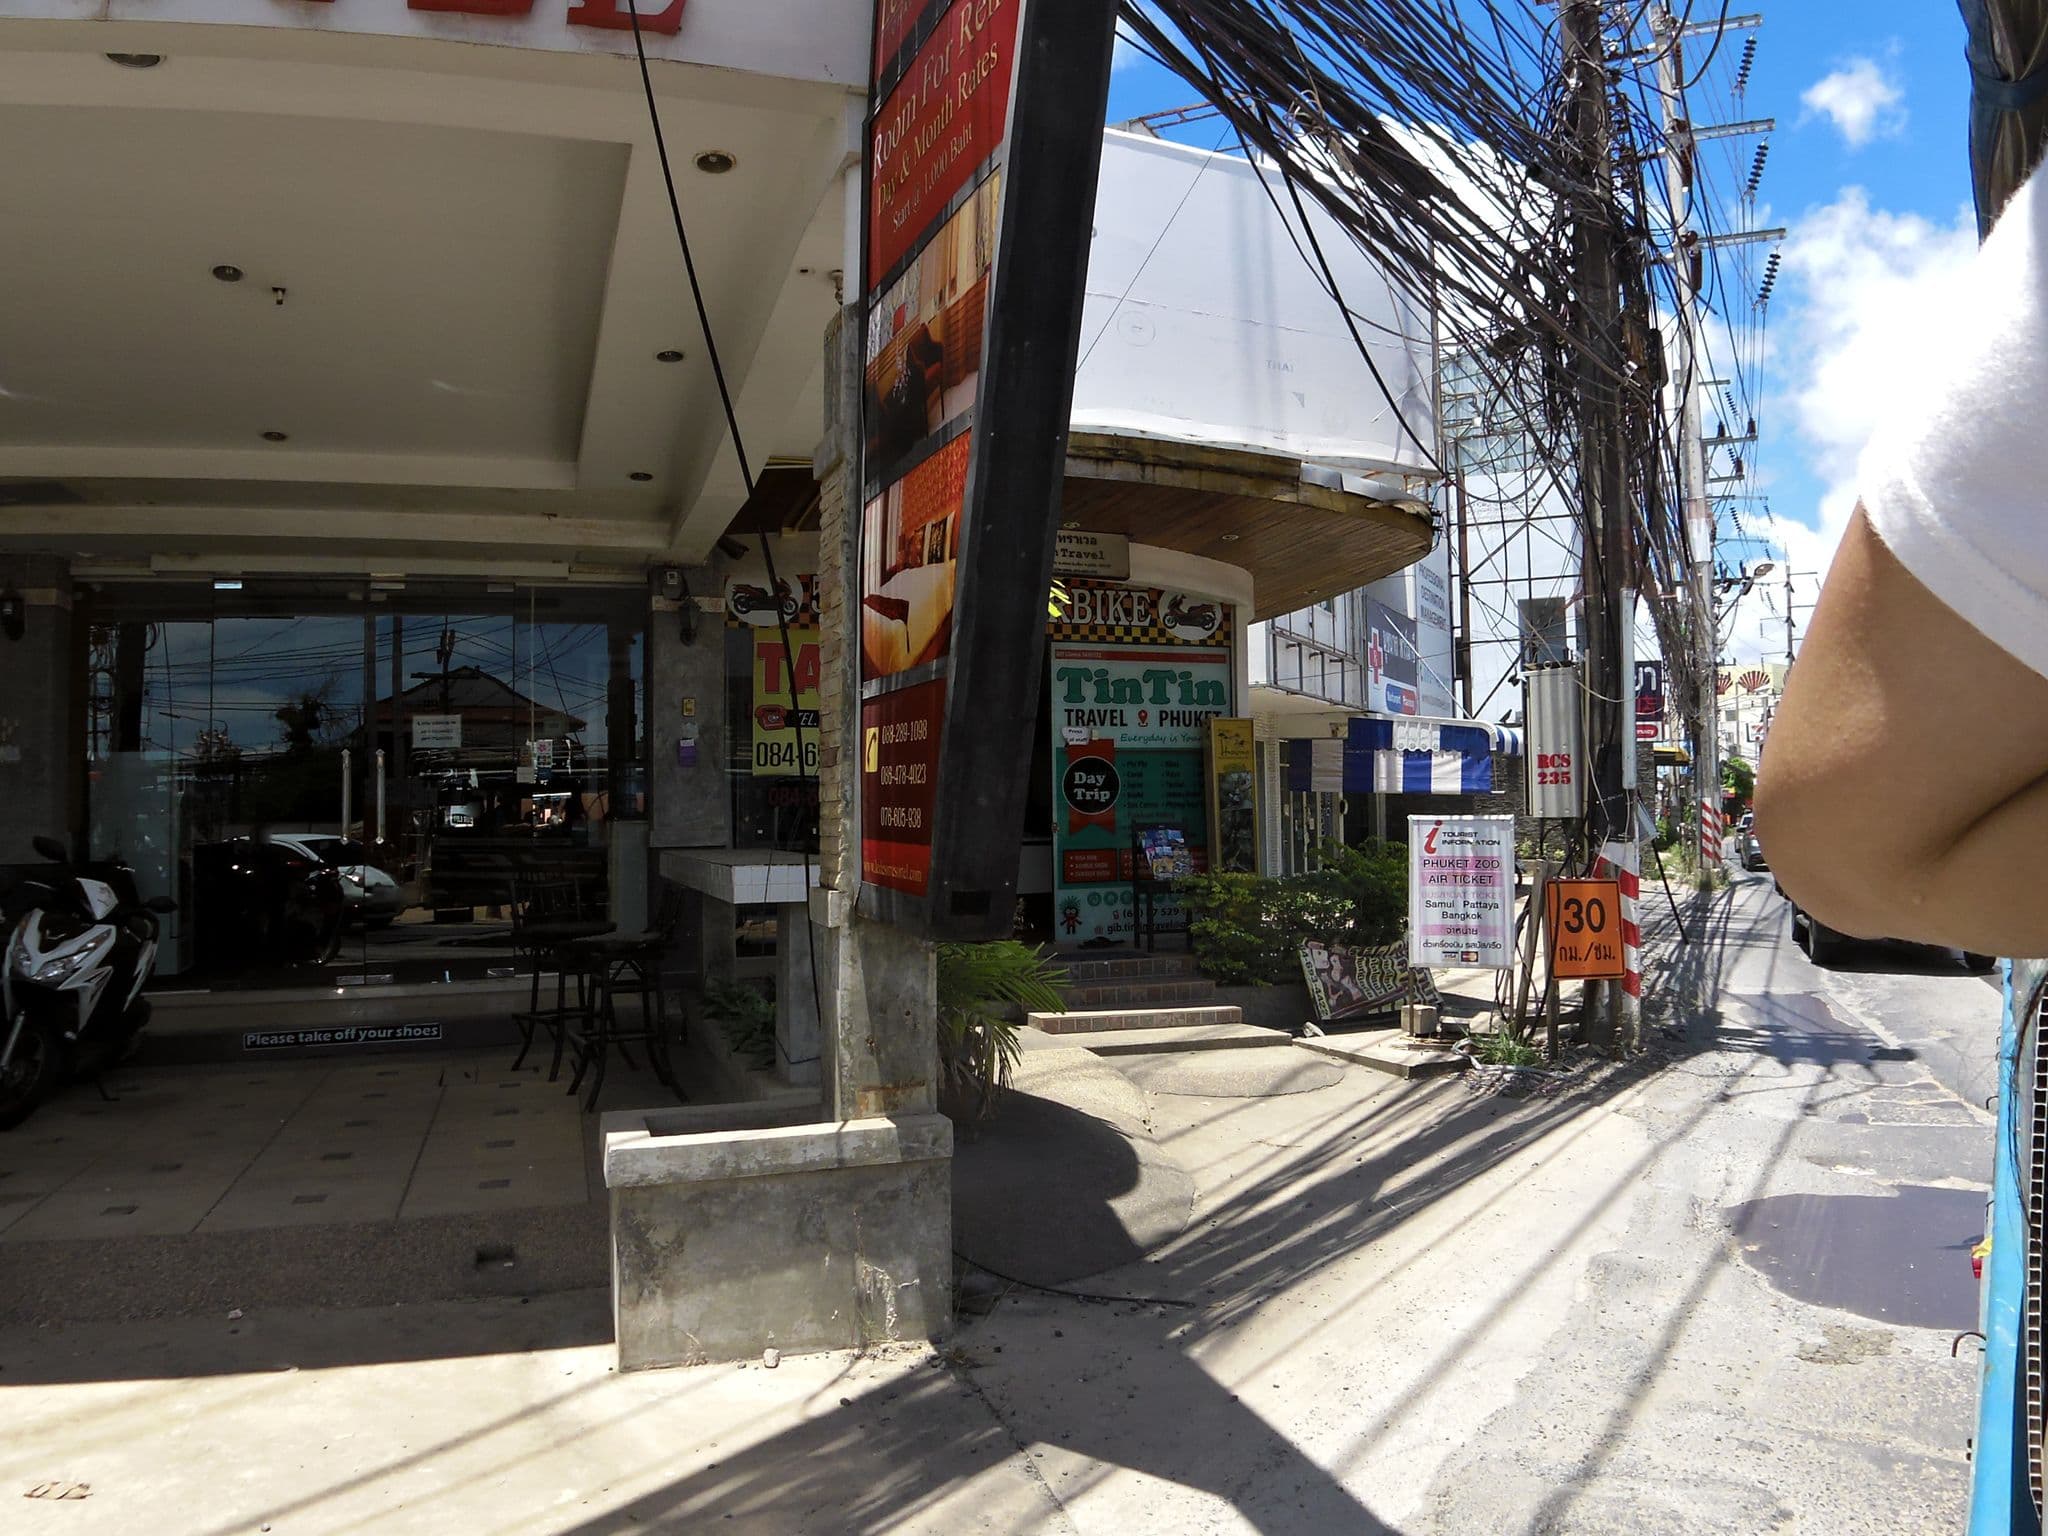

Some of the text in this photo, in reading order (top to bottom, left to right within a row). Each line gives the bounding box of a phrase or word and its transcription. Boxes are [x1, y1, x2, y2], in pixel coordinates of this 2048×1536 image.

[873, 94, 917, 179] Room
[922, 39, 954, 107] For
[877, 41, 998, 216] Day & Month Rates
[950, 122, 973, 163] Baht
[1061, 548, 1105, 560] Travel
[1056, 666, 1227, 706] TinTin
[1064, 708, 1128, 727] TRAVEL
[1120, 733, 1167, 744] Everyday
[756, 742, 820, 767] 084-6
[1537, 754, 1571, 768] RCS
[1074, 771, 1105, 786] Day
[1537, 772, 1571, 785] 235
[1074, 788, 1111, 802] Trip
[1423, 859, 1500, 869] PHUKET ZOO
[1428, 875, 1493, 885] AIR TICKET
[1425, 900, 1499, 910] Samui Pattaya
[1441, 911, 1482, 921] Bangkok
[1563, 898, 1606, 934] 30
[1559, 942, 1616, 962] กม./ชม.
[246, 1025, 438, 1046] Please take off your shoes
